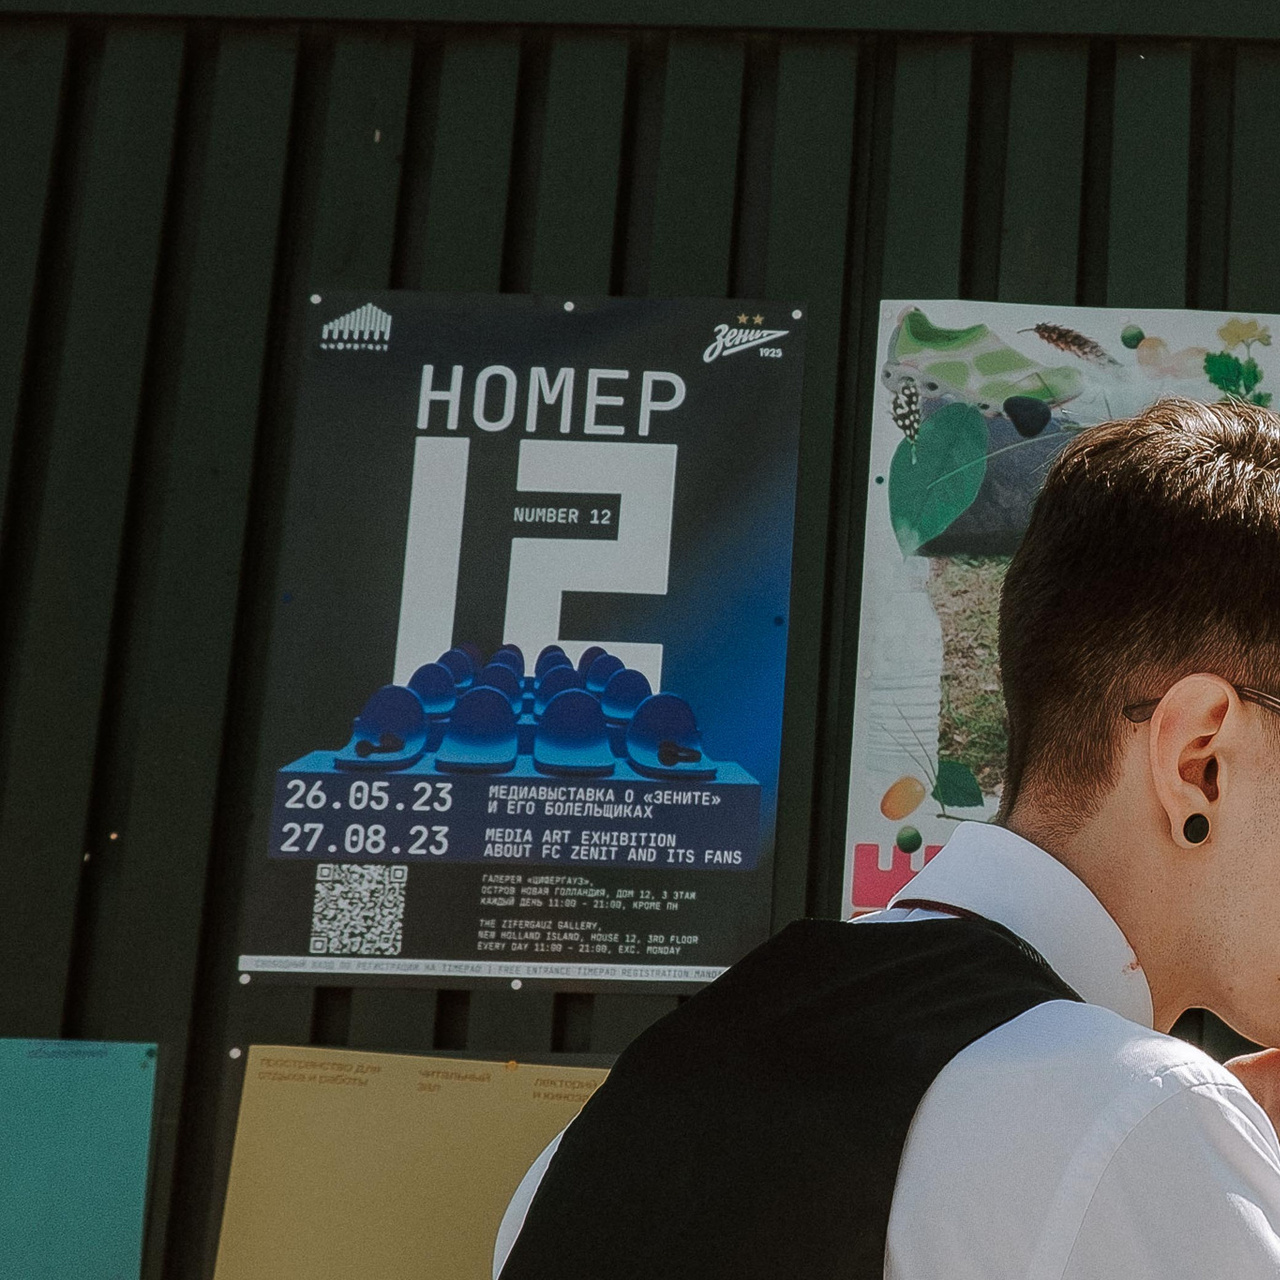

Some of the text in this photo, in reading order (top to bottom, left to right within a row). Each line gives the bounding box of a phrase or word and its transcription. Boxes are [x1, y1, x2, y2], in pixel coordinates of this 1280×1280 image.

[759, 348, 783, 358] 1925
[416, 364, 687, 437] НОМЕР
[513, 506, 612, 524] NUMBER 12
[393, 436, 678, 696] 12
[285, 779, 453, 812] 26.05.23
[488, 785, 721, 805] МЕДИАВЫСТАВКА О «ЗЕНИТЕ»
[488, 801, 653, 819] И ЕГО БОЛЕЛЬЩИКАХ
[280, 822, 450, 856] 27.08.23
[484, 828, 677, 847] MEDIA ART EXHIBITION
[484, 844, 743, 865] ABOUT FC ZENIT AND ITS FANS
[482, 874, 522, 884] ГАЛЕРЕЯ
[481, 886, 516, 895] ОСТРОВ
[521, 886, 549, 896] НОВАЯ
[615, 889, 634, 899] ДОМ
[639, 890, 656, 901] 12,
[661, 890, 668, 900] 3
[673, 890, 697, 901] ЭТАЖ
[519, 898, 543, 907] ДЕНЬ
[548, 898, 577, 908] 11:00
[593, 899, 627, 910] 21:00,
[632, 900, 661, 910] КРОМЕ
[666, 901, 679, 911] ПН
[480, 919, 496, 928] THE
[557, 920, 602, 932] GALLERY,
[478, 930, 699, 944] NEW HOLLAND ISLAND, HOUSE 12, 3RD FLOOR
[477, 941, 682, 955] EVERY DAY 11:00 21:00, EXC. MONDAY
[621, 968, 690, 979] REGISTRATION
[318, 1072, 369, 1087] работы
